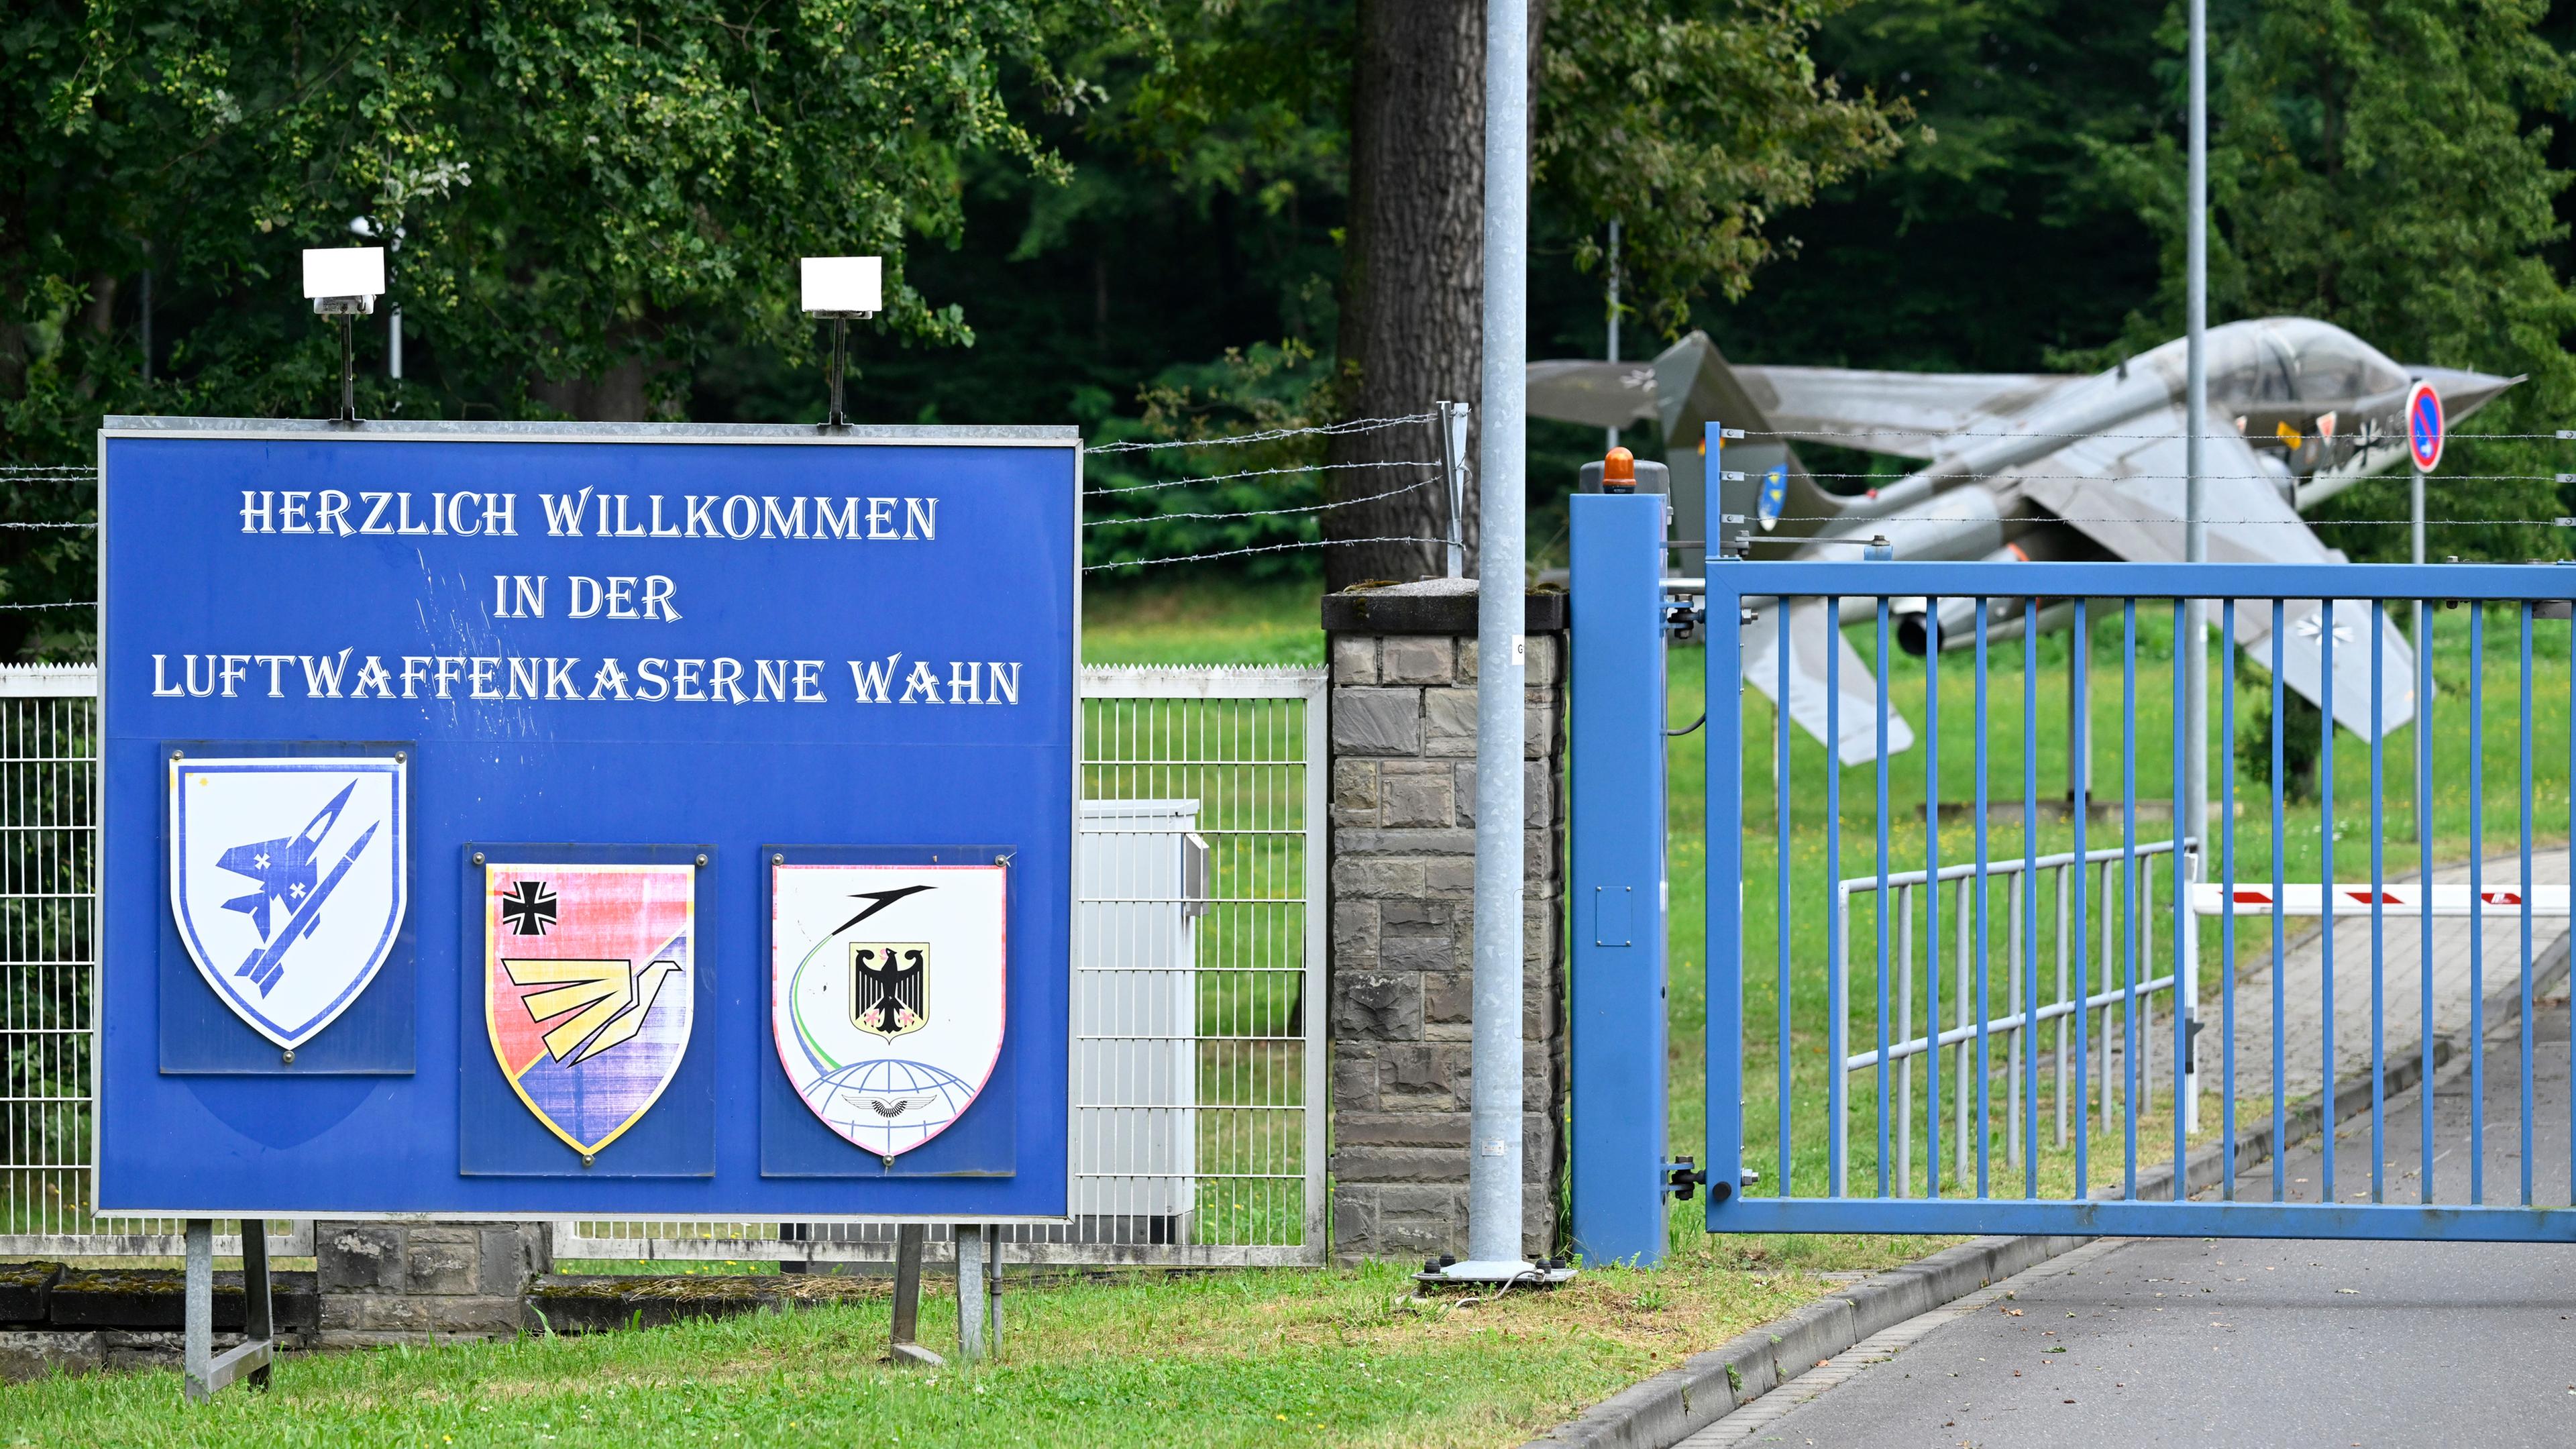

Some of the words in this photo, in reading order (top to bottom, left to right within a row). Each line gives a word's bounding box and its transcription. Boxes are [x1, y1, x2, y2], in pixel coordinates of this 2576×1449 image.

[239, 488, 519, 539] HERZLICH
[537, 484, 939, 541] WILLKOMMEN
[493, 574, 547, 619] IN
[568, 575, 683, 623] DER
[151, 646, 826, 705] LUFTWAFFENKASERNE
[846, 651, 1023, 706] WAHN
